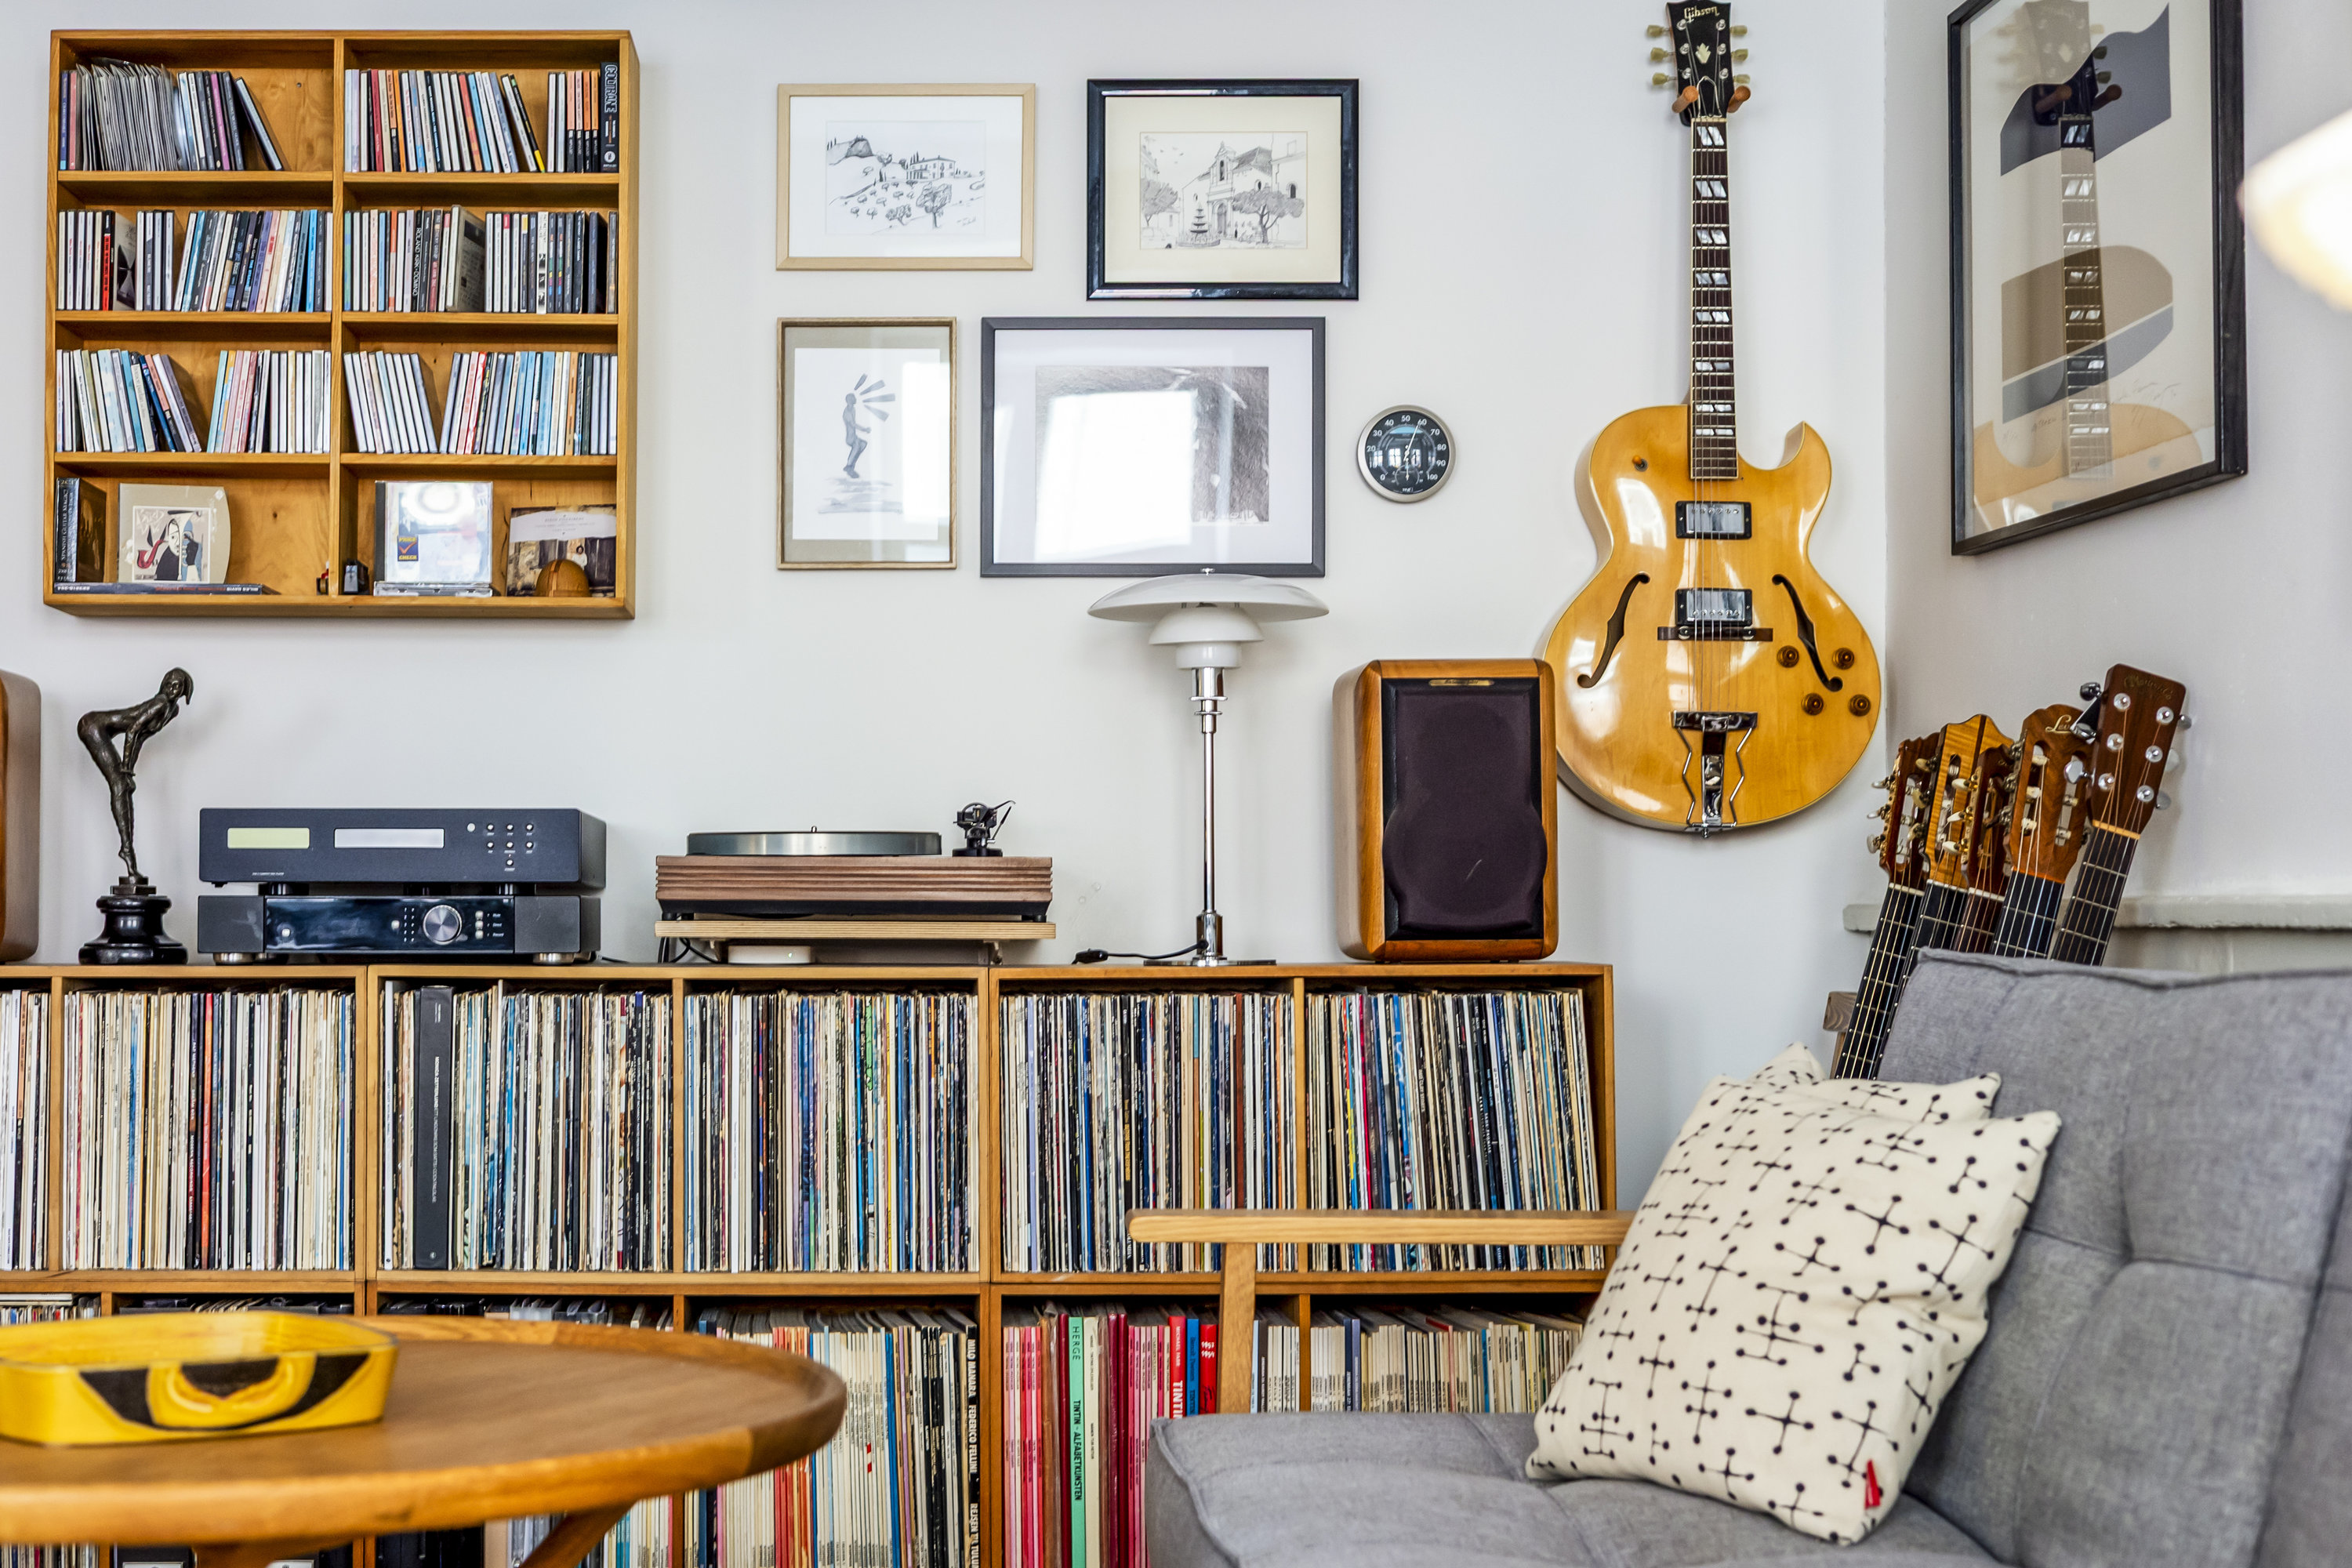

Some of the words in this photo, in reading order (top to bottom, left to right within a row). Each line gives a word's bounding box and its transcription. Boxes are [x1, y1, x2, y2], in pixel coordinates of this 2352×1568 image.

[1683, 5, 1720, 24] Gibson
[604, 64, 618, 113] COLTRANE
[2045, 714, 2071, 734] Lev
[967, 1339, 976, 1359] MILO
[967, 1361, 977, 1397] MANARA
[968, 1405, 977, 1443] FEDERICO
[969, 1444, 978, 1474] FELLINI
[969, 1503, 978, 1533] REJSEN
